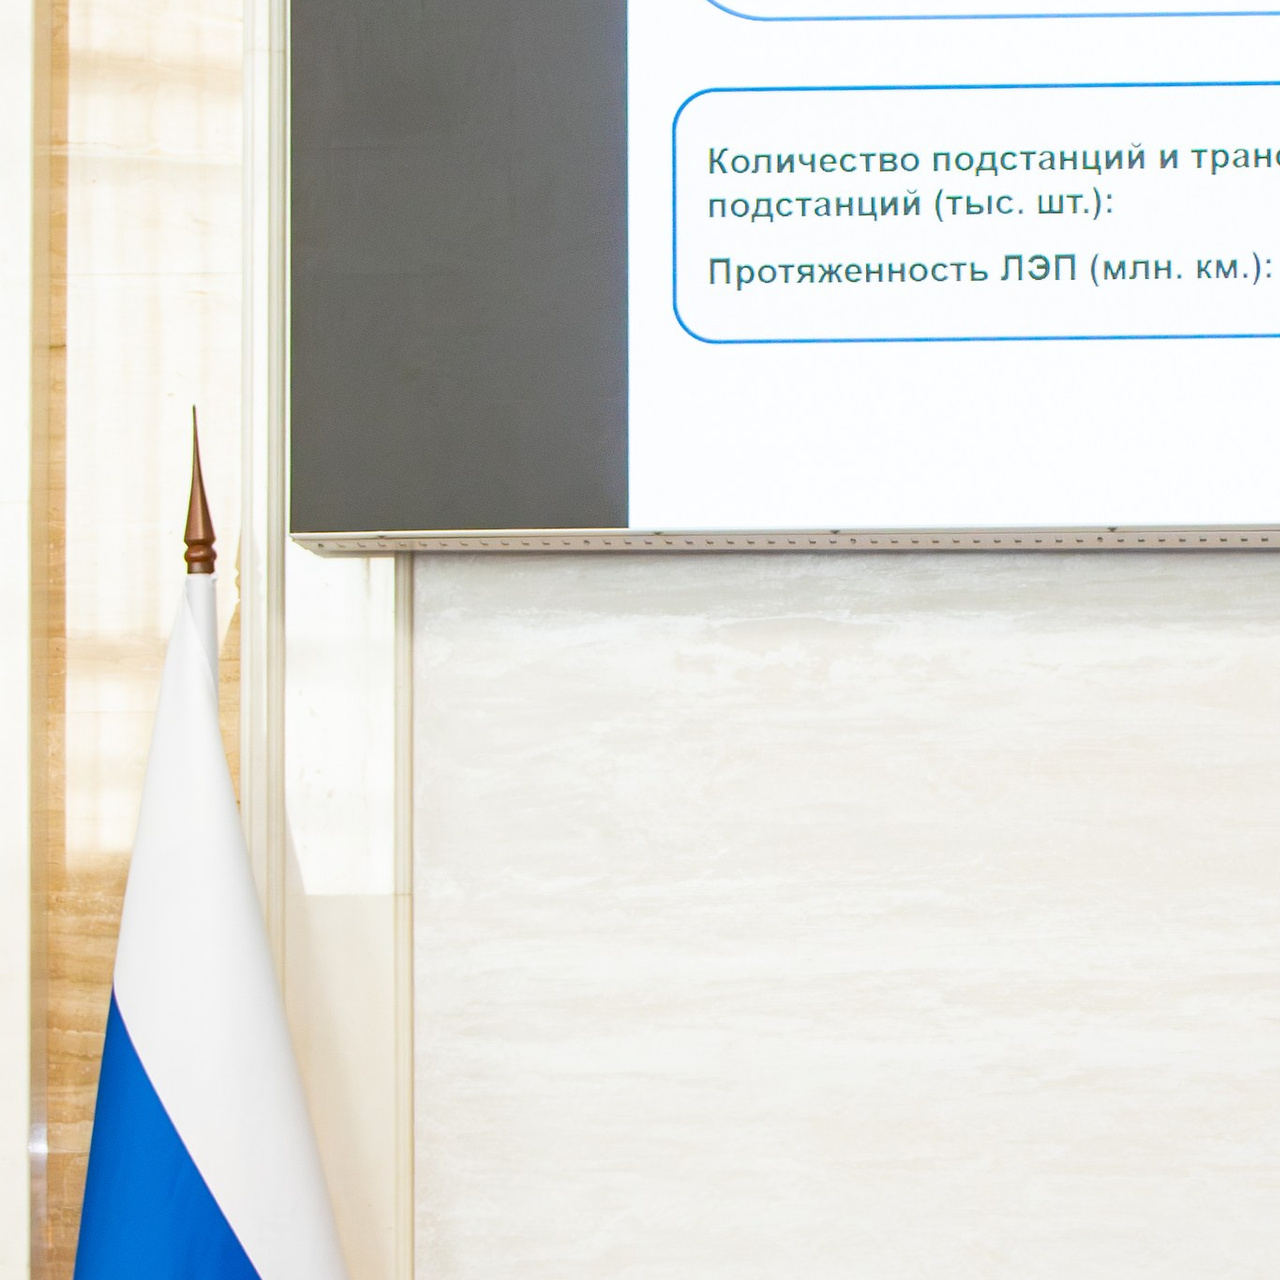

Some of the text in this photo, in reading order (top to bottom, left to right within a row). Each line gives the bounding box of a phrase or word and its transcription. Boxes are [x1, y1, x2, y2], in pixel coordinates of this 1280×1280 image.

[707, 146, 921, 175] Количество
[932, 141, 1146, 178] подстанций
[1158, 147, 1179, 170] и
[708, 188, 922, 224] подстанций
[934, 187, 1024, 223] (тыс.
[1036, 185, 1113, 221] шт.):
[708, 256, 990, 292] Протяженность
[1000, 252, 1077, 282] ЛЭП
[1089, 252, 1183, 288] (млн.
[1196, 250, 1273, 286] км.):
